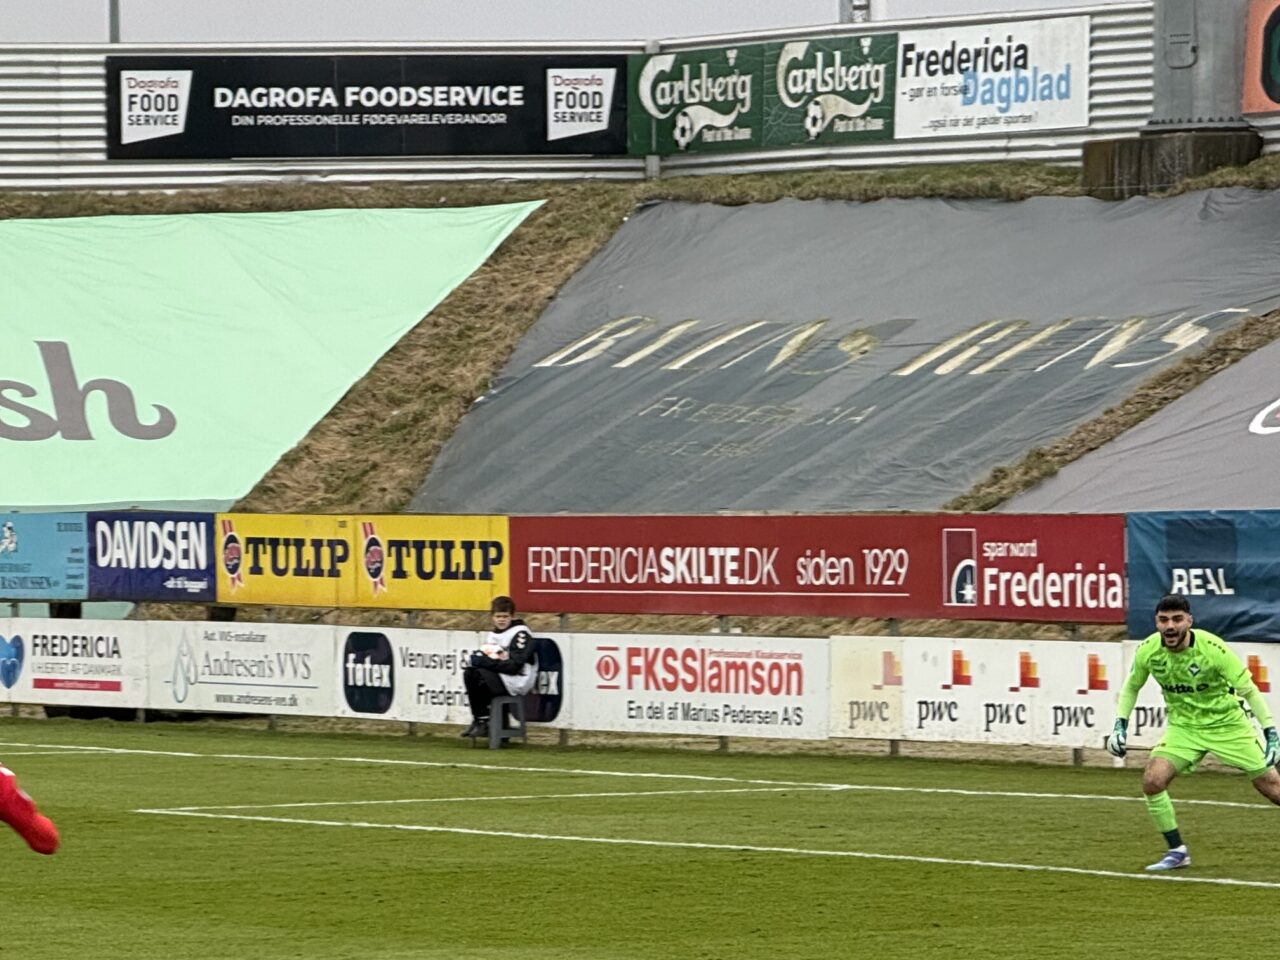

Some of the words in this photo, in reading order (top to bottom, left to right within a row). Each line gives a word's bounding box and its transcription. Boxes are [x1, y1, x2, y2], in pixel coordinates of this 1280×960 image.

[901, 36, 1028, 78] Fredericia
[125, 77, 179, 92] Dagrofa
[552, 75, 604, 90] Dagrofa
[639, 54, 752, 119] Carlsberg
[776, 41, 887, 109] Carlsberg
[961, 64, 1071, 113] Dagblad
[128, 94, 179, 112] FOOD
[214, 86, 336, 109] DAGROFA
[345, 85, 524, 108] FOODSERVICE
[553, 91, 604, 109] FOOD
[128, 115, 179, 126] SERVICE
[232, 115, 254, 126] DIN
[257, 114, 360, 126] PROFESSIONELLE
[362, 113, 508, 125] FØDEVARELEVERANDØR
[553, 111, 604, 123] SERVICE
[95, 520, 207, 570] DAVIDSEN
[245, 537, 349, 578] TULIP
[387, 540, 503, 581] TULIP
[527, 546, 780, 585] FREDERICIASKILTE.DK
[796, 548, 855, 586] siden
[862, 548, 910, 586] 1929
[983, 562, 1123, 609] Fredericia
[1170, 568, 1235, 595] REAL
[32, 634, 122, 658] FREDERICIA
[276, 652, 311, 680] VVS
[399, 647, 457, 675] Venusvej
[416, 683, 470, 707] Frederic
[627, 700, 644, 719] En
[646, 701, 664, 720] del
[667, 701, 679, 720] af
[681, 702, 720, 722] Marius
[723, 704, 778, 725] Pedersen
[849, 699, 889, 728] pwc
[918, 699, 959, 728] pwc
[984, 701, 1027, 731] pwc
[1052, 703, 1095, 735] pwc
[1134, 705, 1168, 736] pw
